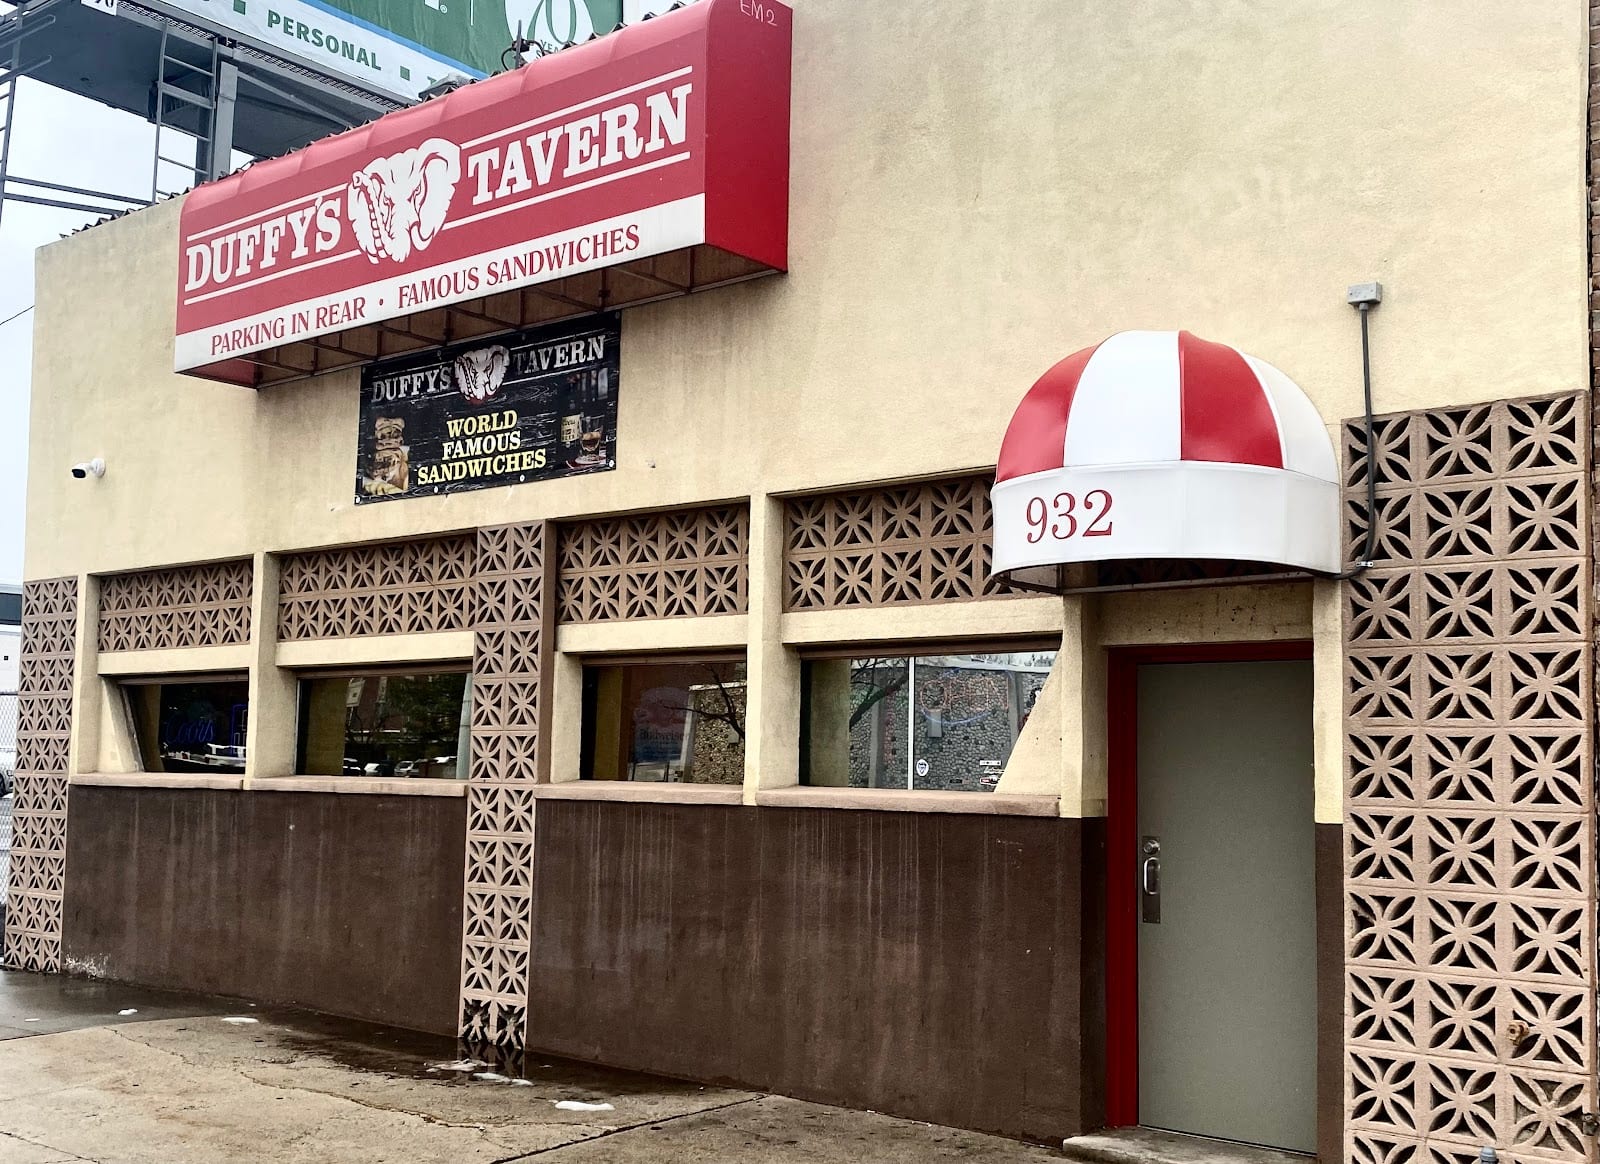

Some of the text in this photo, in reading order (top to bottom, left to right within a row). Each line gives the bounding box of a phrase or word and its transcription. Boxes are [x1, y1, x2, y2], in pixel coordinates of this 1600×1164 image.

[267, 9, 382, 71] PERSONAL
[185, 83, 693, 292] DUFFY'S TAVERN
[211, 224, 640, 356] PARKING IN REAR FAMOUS SANDWICHES
[371, 335, 606, 403] DUFFY'S TAVERN
[442, 430, 521, 461] FAMOUS
[446, 409, 518, 438] WORLD
[417, 448, 547, 485] SANDWICHES
[1026, 489, 1113, 544] 932
